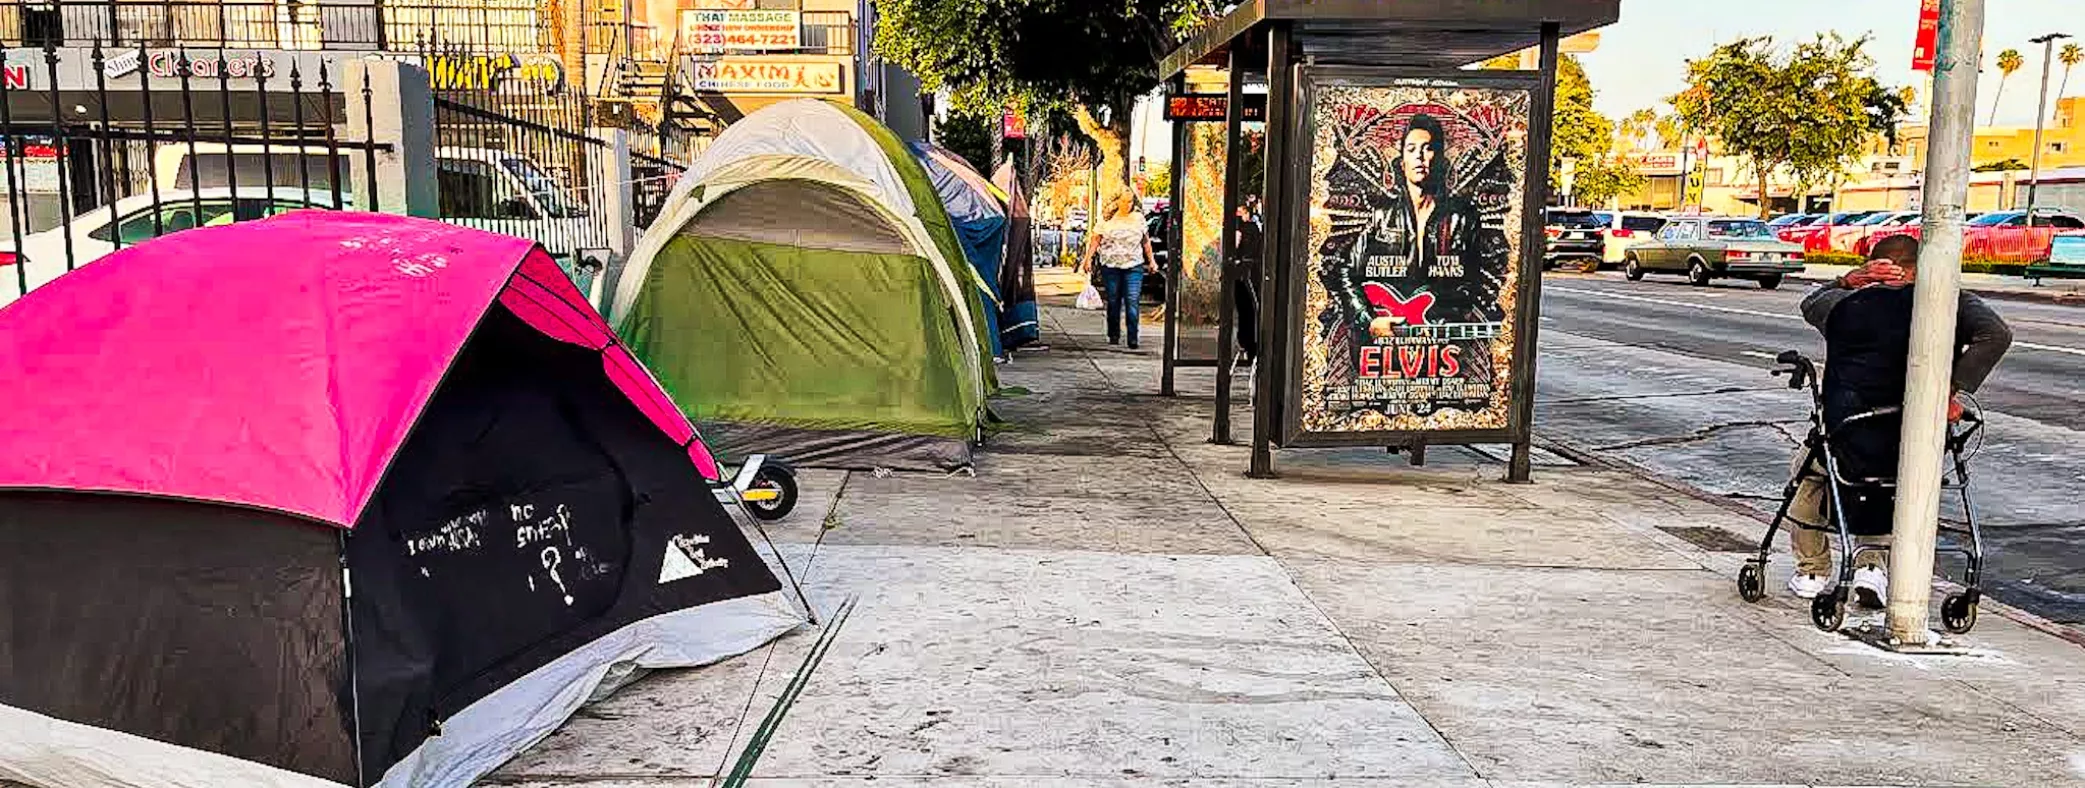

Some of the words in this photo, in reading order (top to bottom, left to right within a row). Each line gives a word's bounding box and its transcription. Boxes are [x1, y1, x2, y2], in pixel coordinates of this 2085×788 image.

[694, 12, 725, 22] THAI
[728, 12, 793, 22] MASSAGE
[698, 63, 790, 80] MAXIM
[699, 80, 755, 88] CHINESE
[1367, 255, 1407, 267] AUSTIN
[1436, 255, 1459, 267] TOM
[1365, 266, 1408, 278] BUTLER
[1428, 265, 1465, 278] HANKS
[1359, 345, 1462, 379] ELVIS
[1384, 402, 1412, 415] JUNE
[1416, 401, 1432, 414] 24
